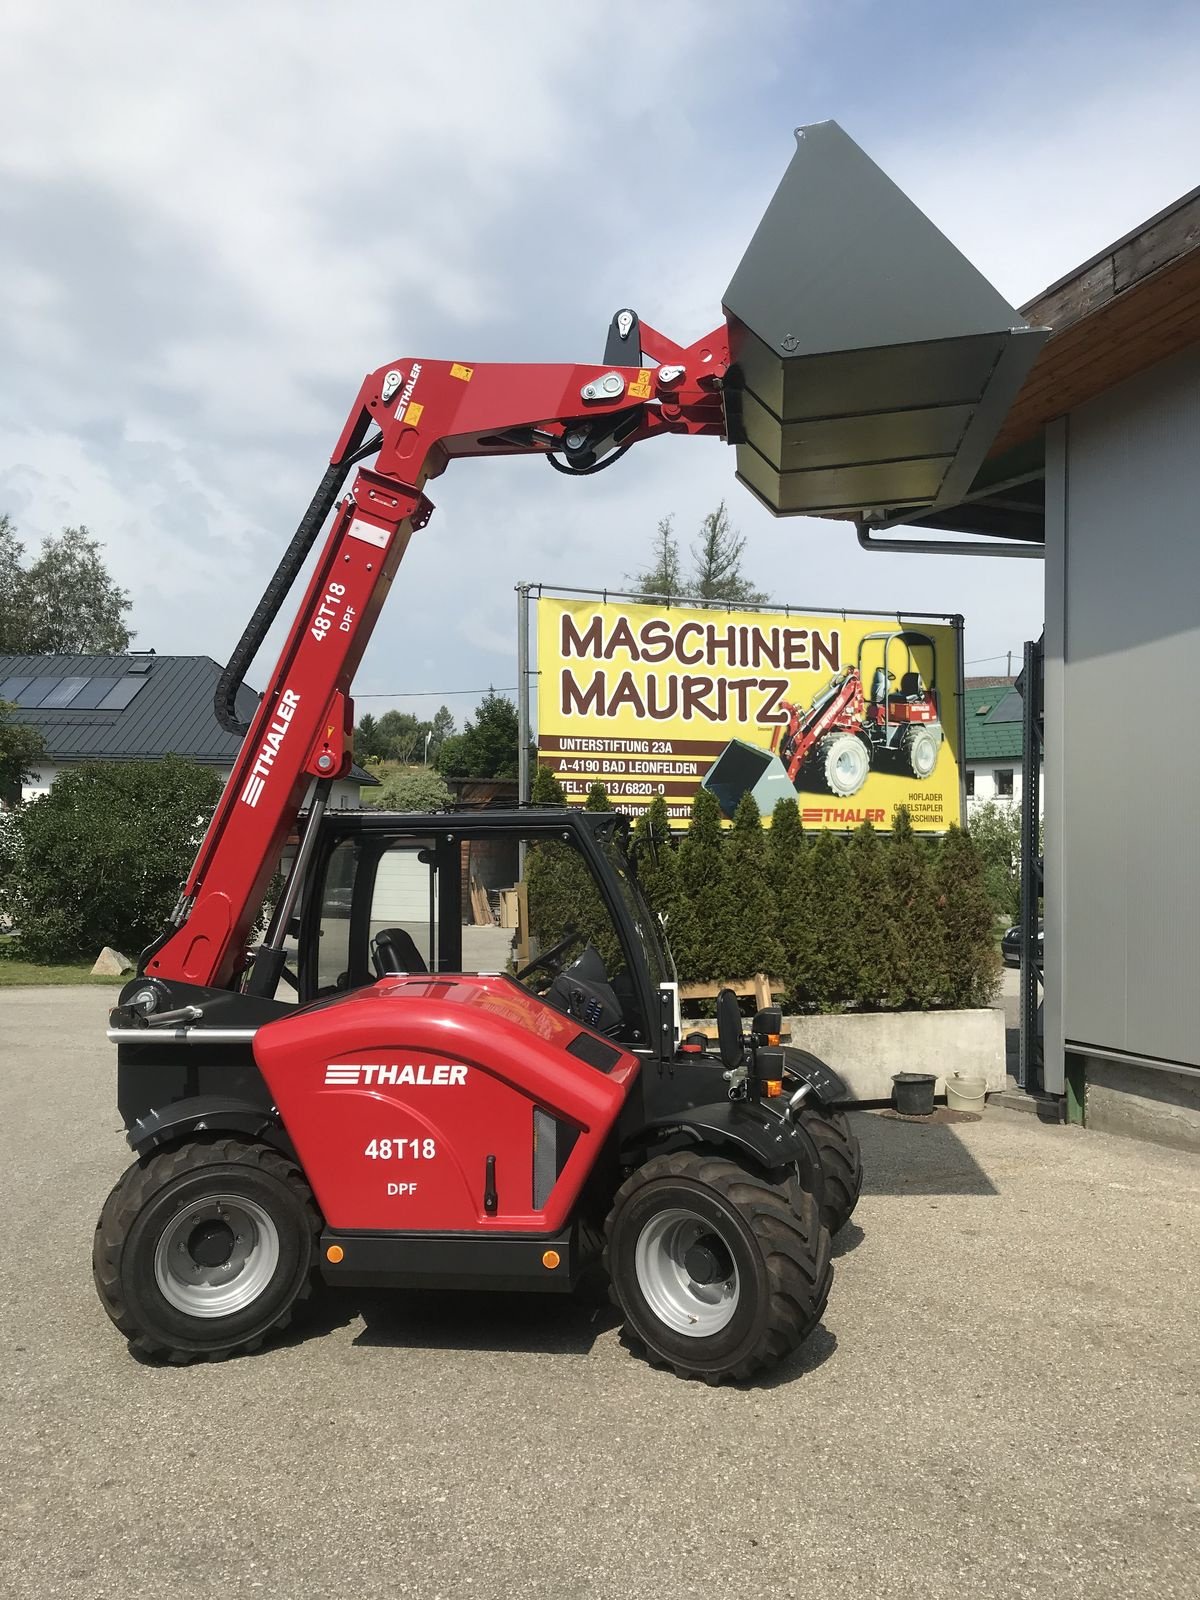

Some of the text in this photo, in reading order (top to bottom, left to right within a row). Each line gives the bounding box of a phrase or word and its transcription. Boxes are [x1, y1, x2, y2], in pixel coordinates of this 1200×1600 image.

[311, 581, 346, 642] 48T18
[339, 605, 356, 632] DPF
[561, 614, 839, 671] MASCHINEN
[561, 669, 789, 723] MAURITZ
[251, 688, 301, 781] THALER
[559, 738, 673, 754] UNTERSTIFTUNG 23A
[559, 759, 698, 775] A-4190 BAD LEONFELDEN
[559, 781, 665, 795] TEL: 013/6820-0
[908, 792, 943, 801] HOFLADER
[822, 808, 885, 823] THALER
[891, 814, 943, 823] BASCHINEN
[362, 1064, 469, 1086] THALER
[364, 1138, 436, 1160] 48T18
[387, 1182, 418, 1196] DPF
